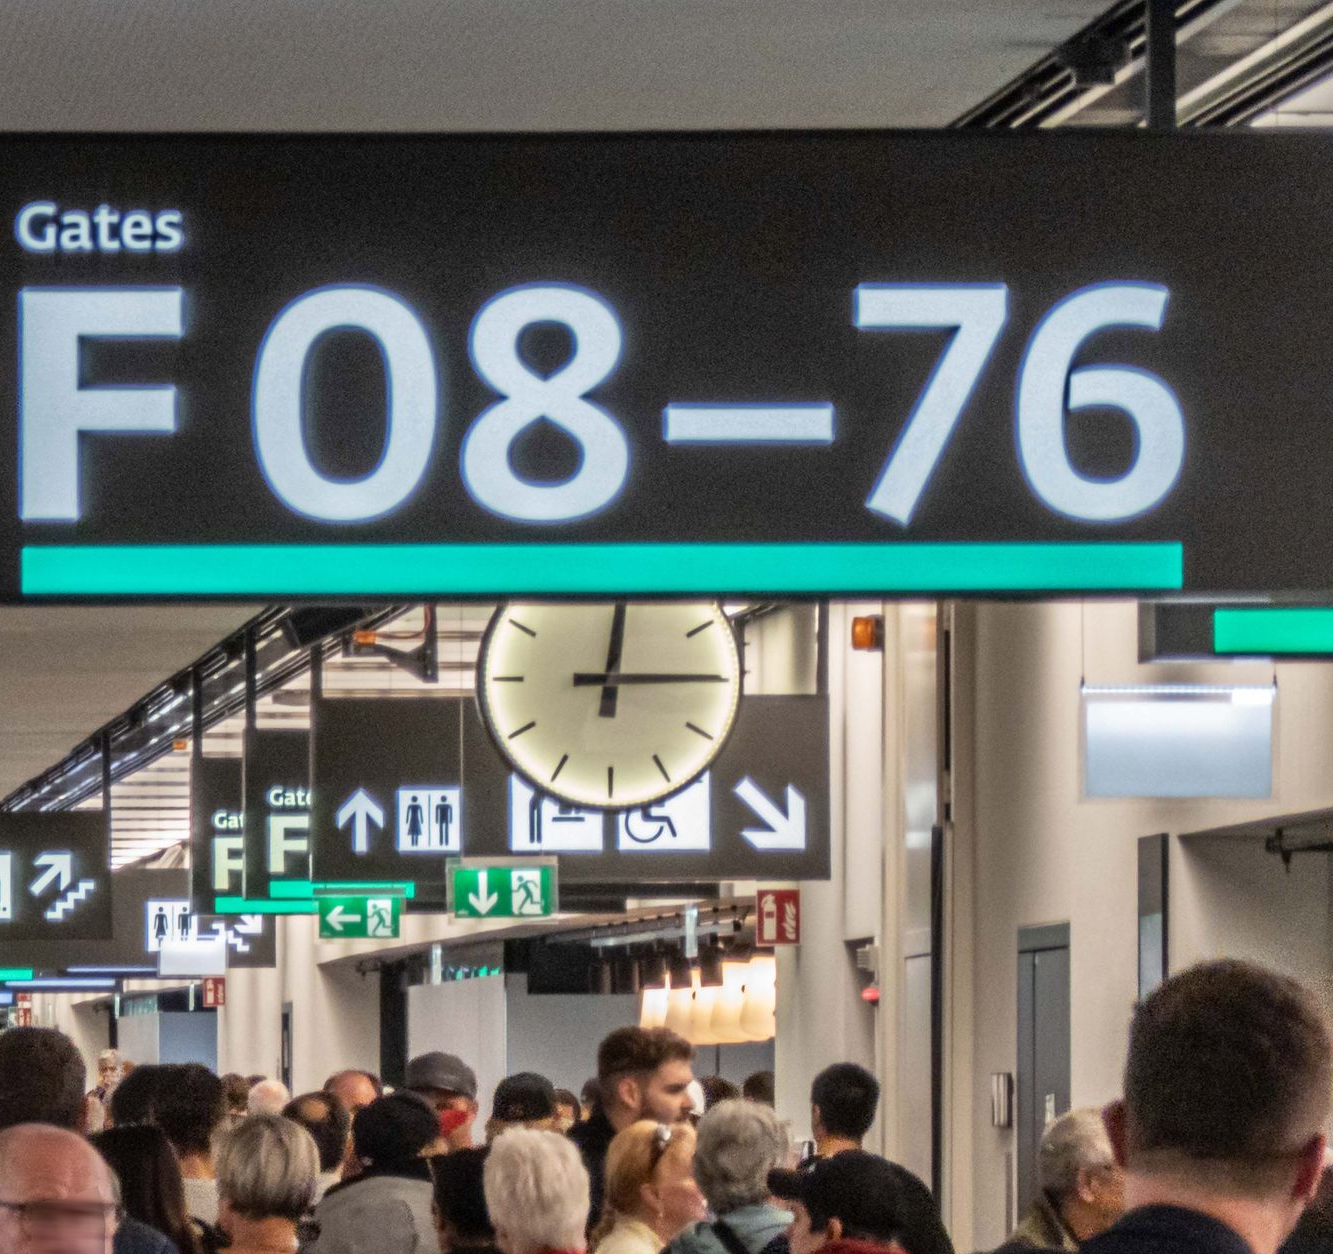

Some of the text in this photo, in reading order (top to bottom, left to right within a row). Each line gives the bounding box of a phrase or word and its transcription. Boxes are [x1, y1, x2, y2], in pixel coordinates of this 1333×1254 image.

[18, 202, 185, 252] Gates
[19, 285, 184, 523] F
[214, 812, 243, 829] Gat
[269, 814, 310, 873] F
[213, 836, 244, 890] F
